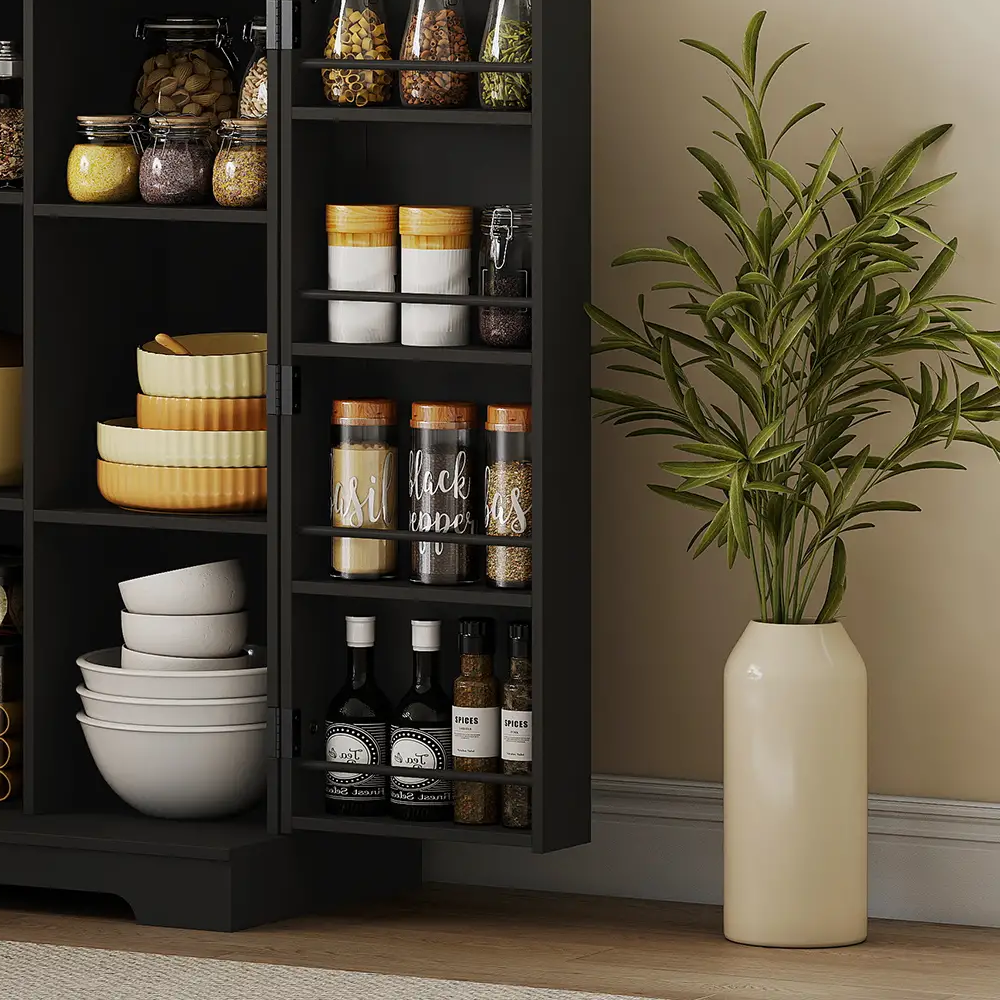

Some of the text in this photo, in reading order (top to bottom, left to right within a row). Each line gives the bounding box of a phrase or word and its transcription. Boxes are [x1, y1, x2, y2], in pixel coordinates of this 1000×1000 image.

[330, 452, 393, 528] asil
[454, 716, 479, 725] SPICES
[504, 719, 528, 728] SPICES
